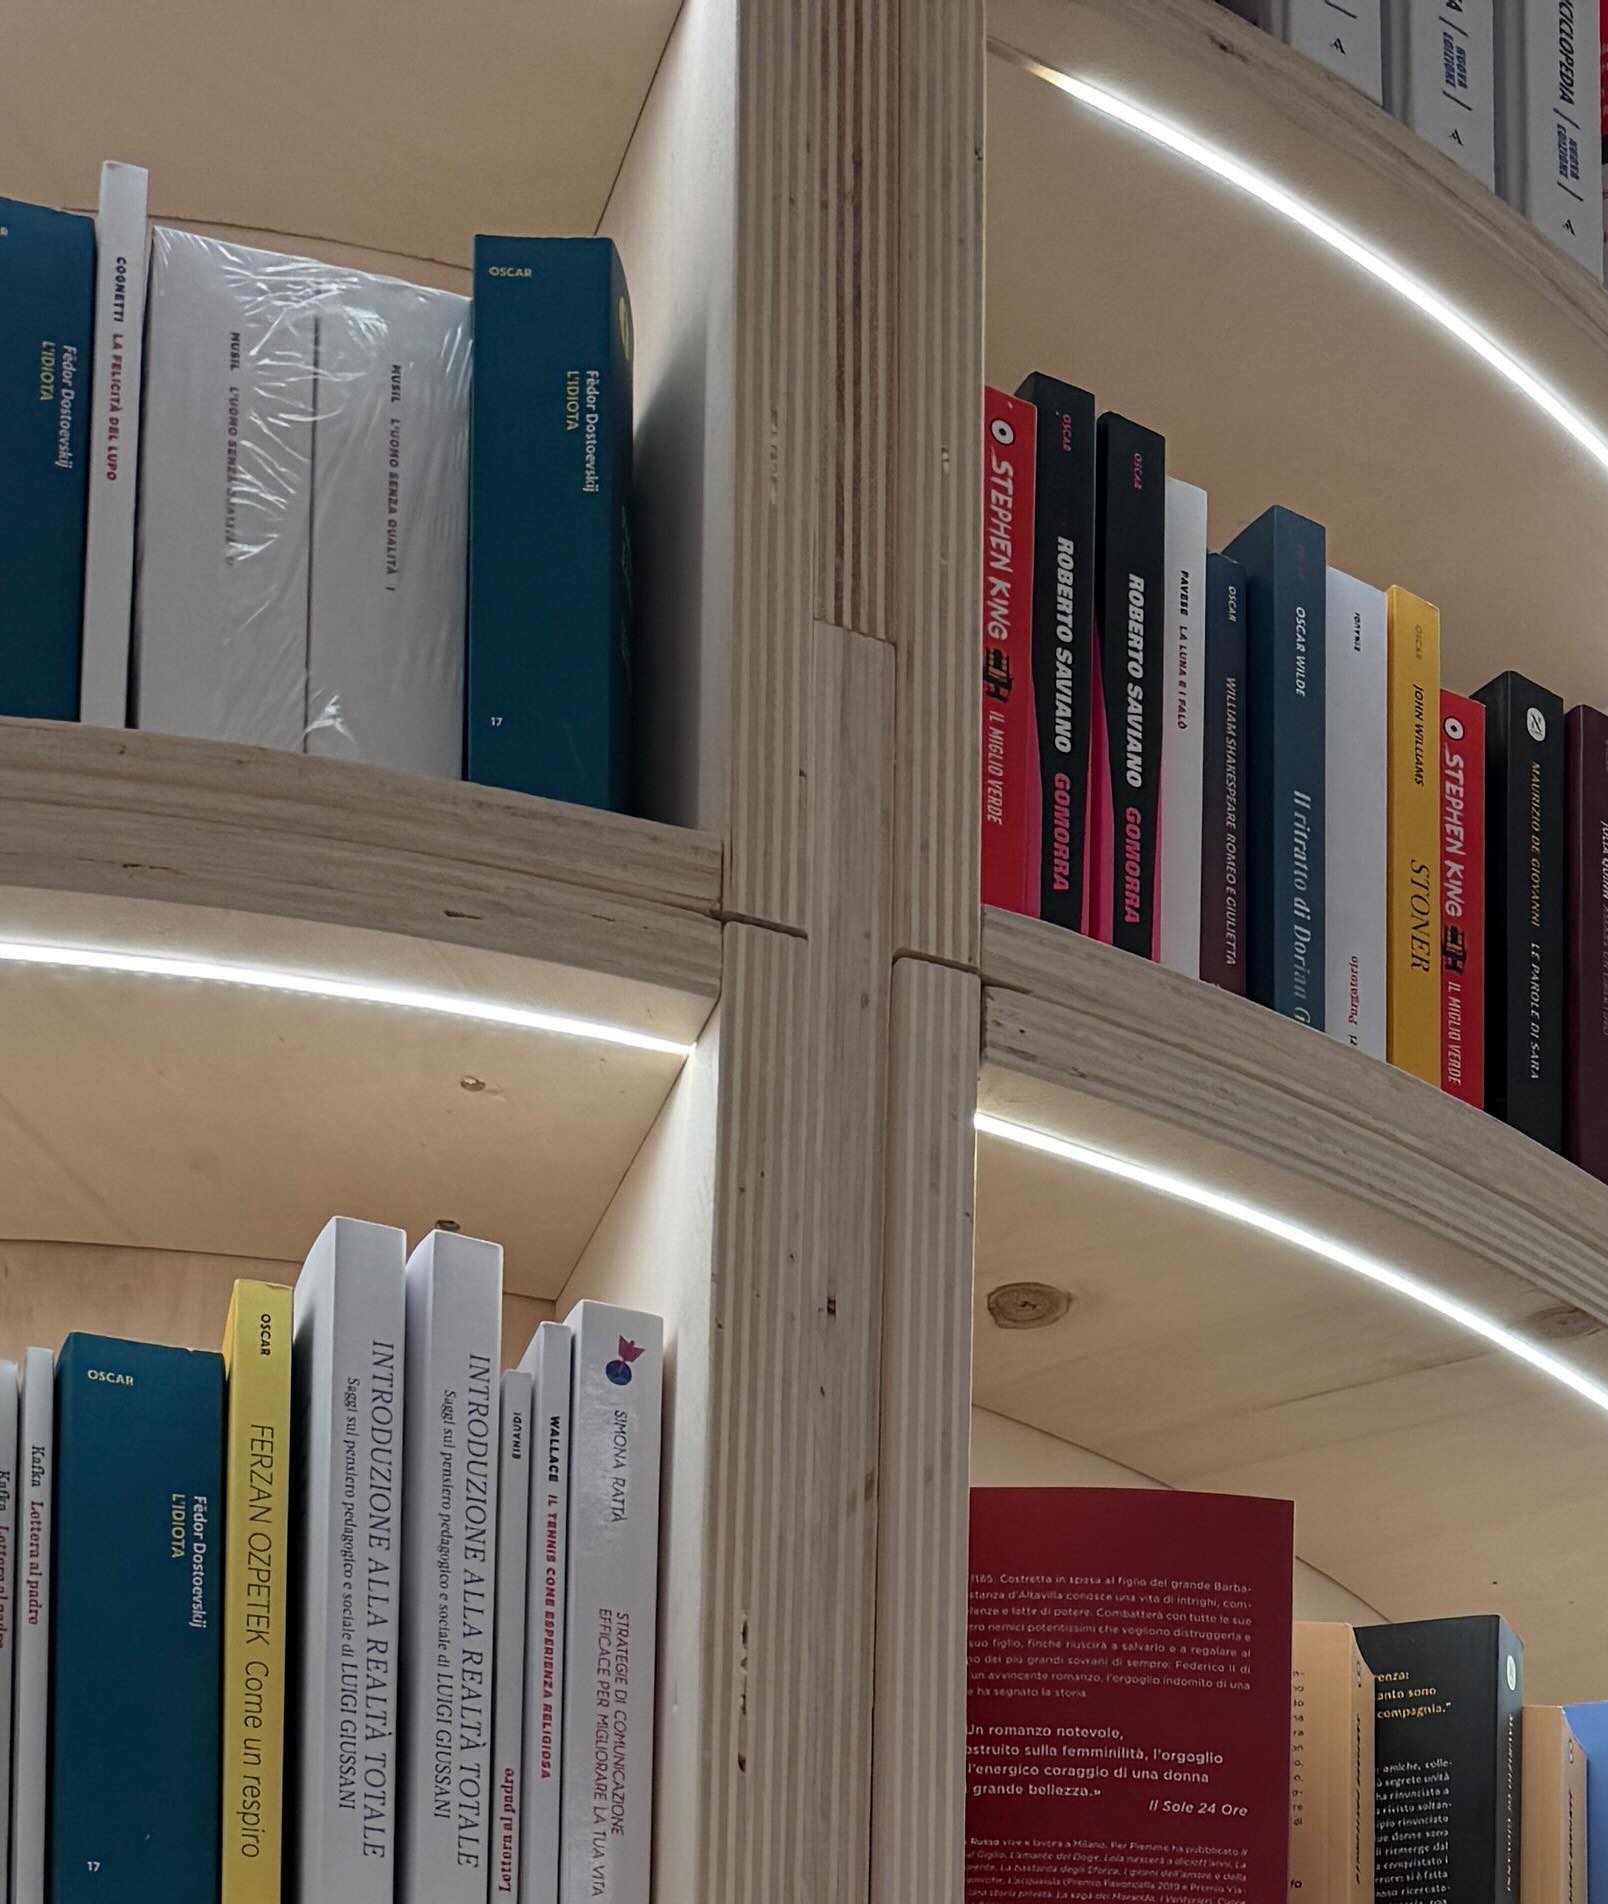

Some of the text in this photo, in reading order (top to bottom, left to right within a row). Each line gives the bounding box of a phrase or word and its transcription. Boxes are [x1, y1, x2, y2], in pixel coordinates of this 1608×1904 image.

[114, 257, 126, 322] COGNETTI
[489, 266, 532, 277] OSCAR
[106, 334, 123, 481] LA FELICITÀ DEL LUPO
[566, 371, 579, 430] L'IDIOTA
[987, 454, 1013, 640] STEPHEN KING
[1055, 537, 1076, 753] ROBERTO SAVIANO
[1296, 607, 1306, 696] OSCAR WILDE
[1413, 684, 1423, 785] JOHN WILLIAMS
[1053, 773, 1070, 890] GOMORRA
[1294, 812, 1311, 890] ritratto
[1444, 747, 1466, 917] STEPHEN KING
[1294, 897, 1311, 920] di
[1411, 859, 1430, 972] STONER
[1294, 924, 1311, 998] Dorian
[1530, 943, 1540, 1078] LE PAROLE DI SARA
[1448, 981, 1461, 1085] IL MIGLIO VERDE
[260, 1314, 271, 1355] OSCAR
[549, 1416, 560, 1482] WALLACE
[612, 1410, 627, 1522] SIMONA RATTÀ
[246, 1424, 274, 1645] FERZAN OZPETEK
[363, 1341, 394, 1858] INTRODUZIONE ALLA REALTÀ TOTALE
[237, 1661, 269, 1858] Come un respiro
[339, 1663, 357, 1809] LUIGI GIUSSANI
[989, 1727, 1051, 1736] romanzo
[1162, 1800, 1194, 1813] Sole
[1198, 1803, 1216, 1814] 24
[1221, 1804, 1248, 1816] Ore
